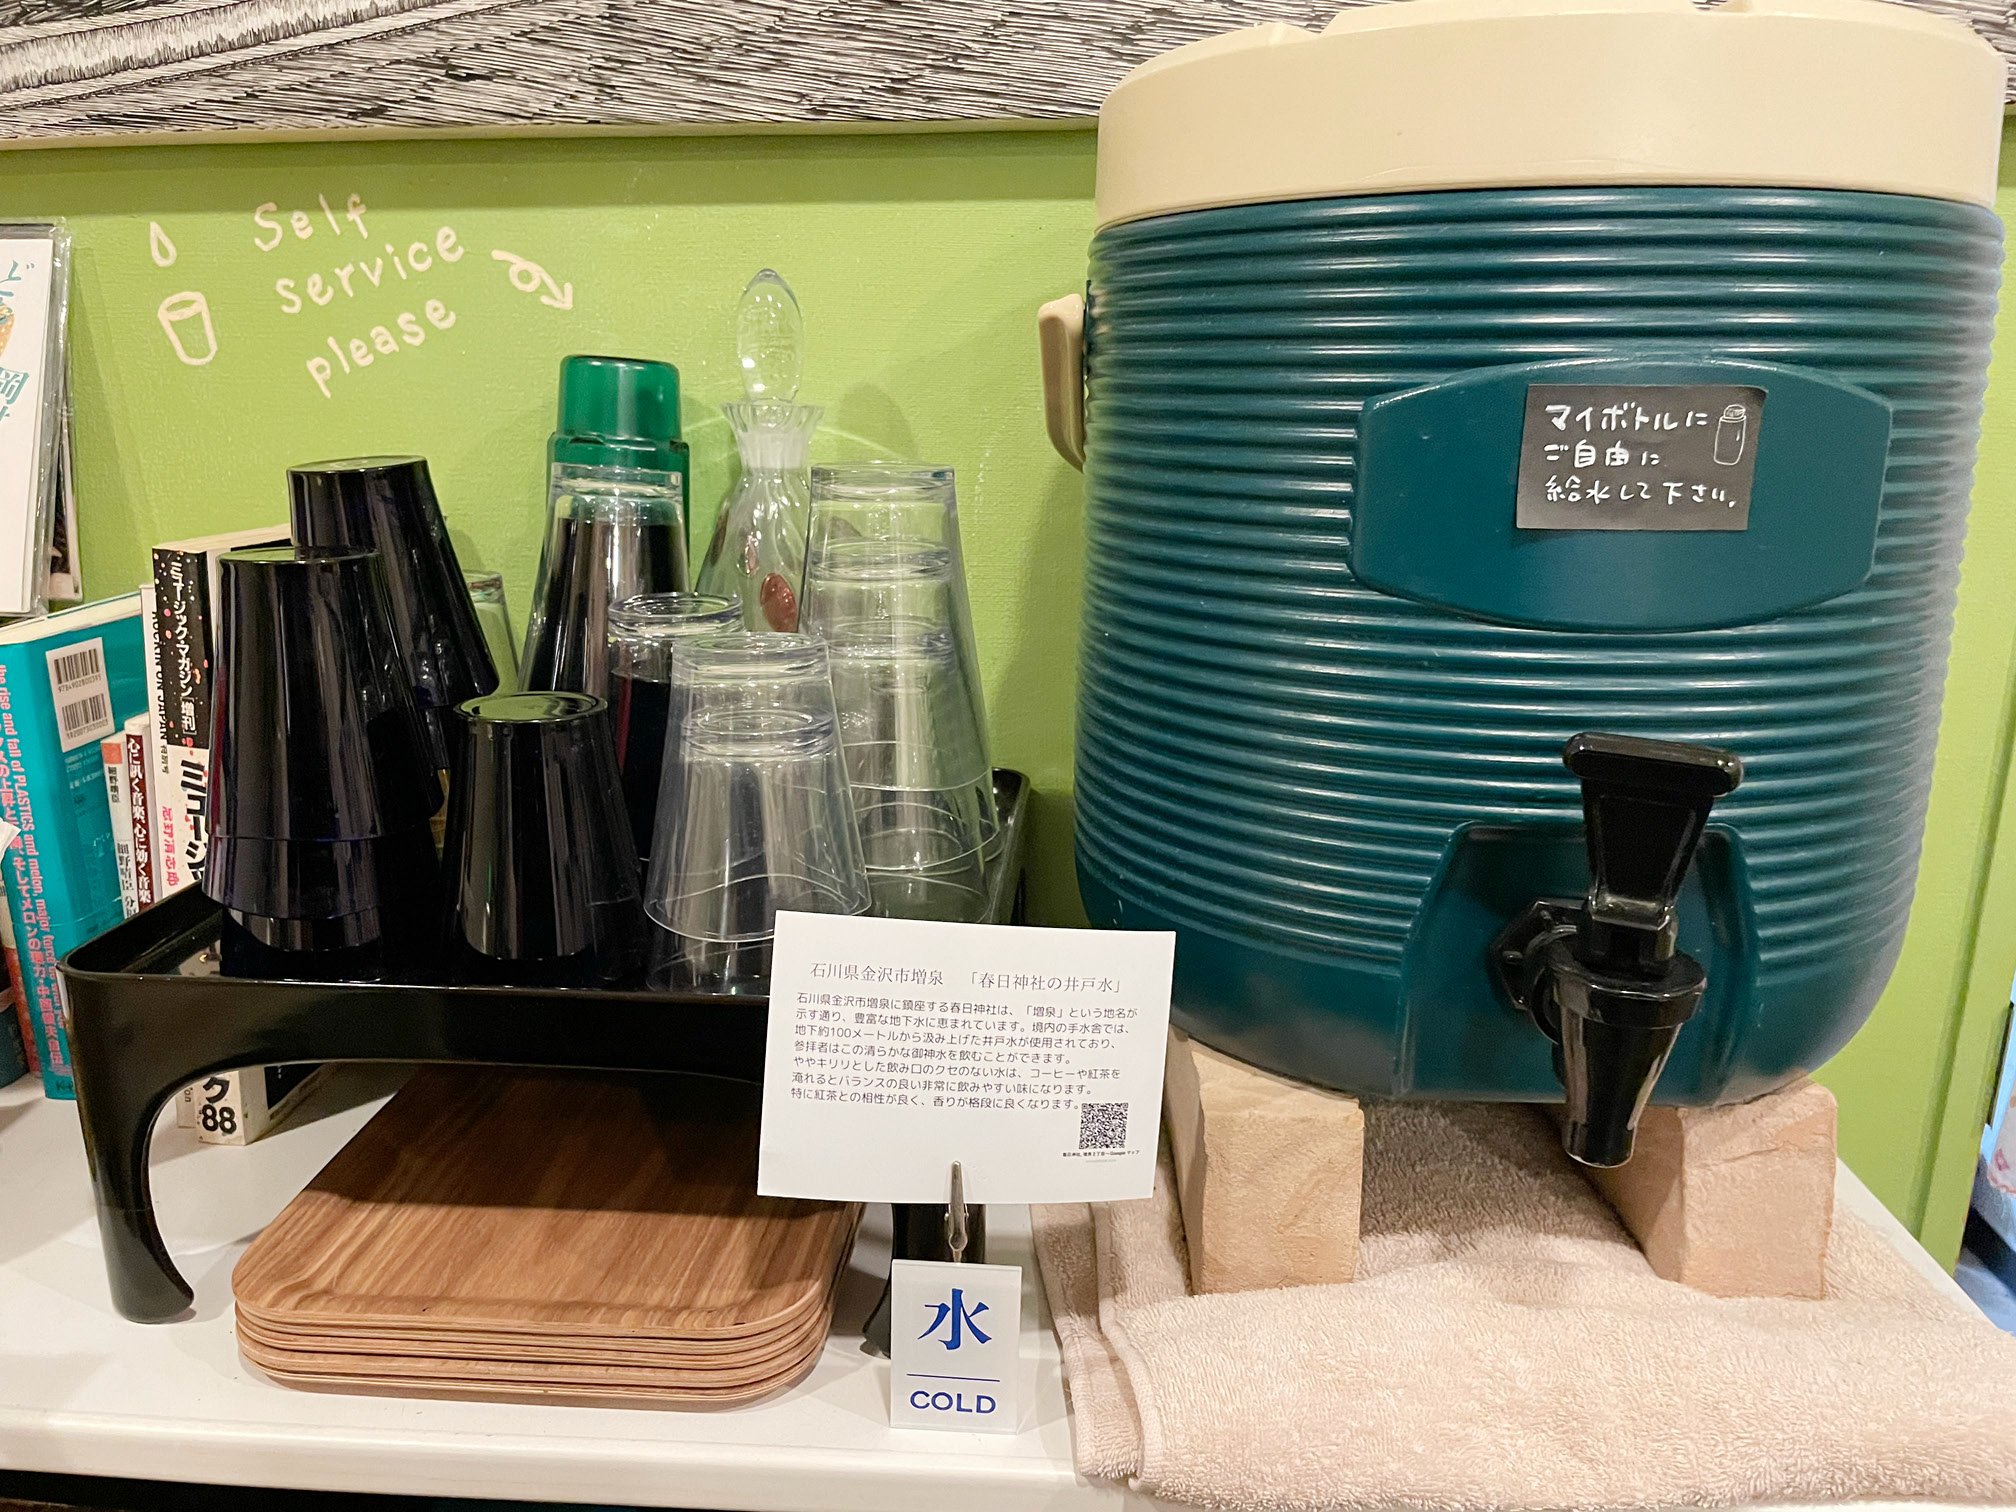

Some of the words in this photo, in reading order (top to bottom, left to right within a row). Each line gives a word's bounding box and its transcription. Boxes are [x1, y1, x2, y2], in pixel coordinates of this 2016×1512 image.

[253, 193, 368, 252] Self
[275, 225, 464, 314] service
[306, 298, 457, 399] please
[1545, 402, 1709, 432] マイボトルに
[1544, 439, 1661, 469] ご自由に
[2, 712, 18, 736] and
[7, 738, 22, 756] fall
[11, 759, 25, 773] of
[14, 774, 35, 832] PLASTICS
[23, 834, 39, 856] and
[35, 899, 51, 932] major
[810, 962, 944, 986] 石川県金沢市増泉
[967, 971, 1122, 994] 「春日神社の井戸水」
[202, 1103, 237, 1134] 88
[917, 1288, 993, 1351] 水
[909, 1390, 997, 1414] COLD
